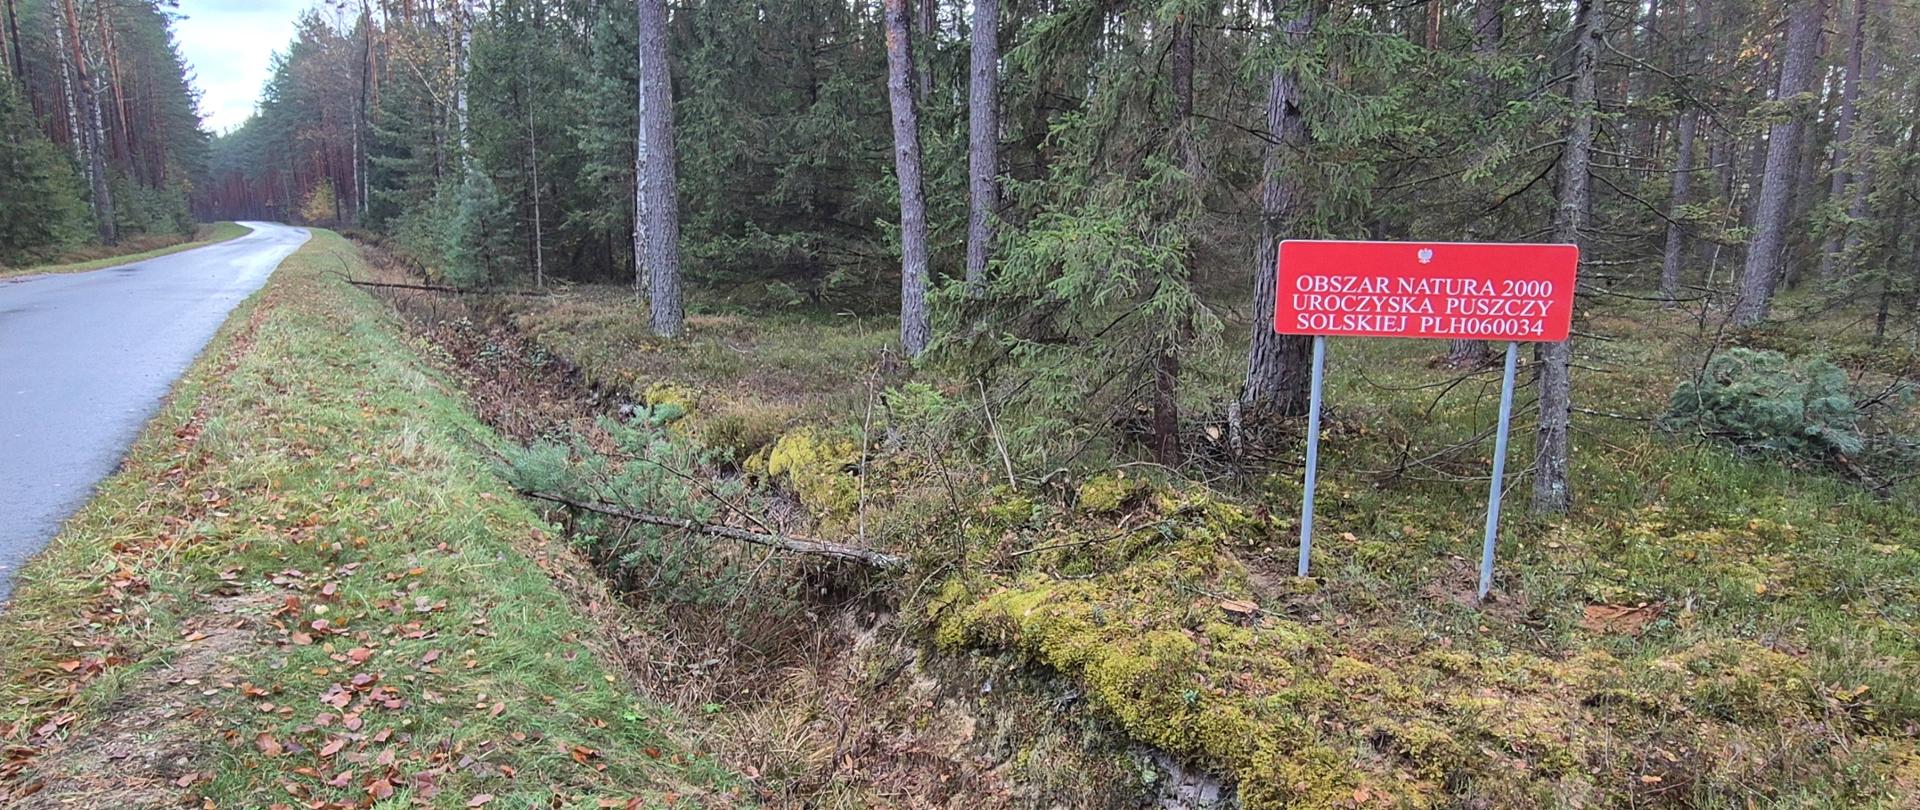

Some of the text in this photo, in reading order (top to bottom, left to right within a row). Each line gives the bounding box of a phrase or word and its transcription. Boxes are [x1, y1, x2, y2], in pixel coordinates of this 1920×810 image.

[1296, 274, 1553, 298] OBSZAR NATURA 2000
[1292, 293, 1554, 317] UROCZYSKA PUSZCZY
[1296, 312, 1544, 337] SOLSKIEJ PLH060034
